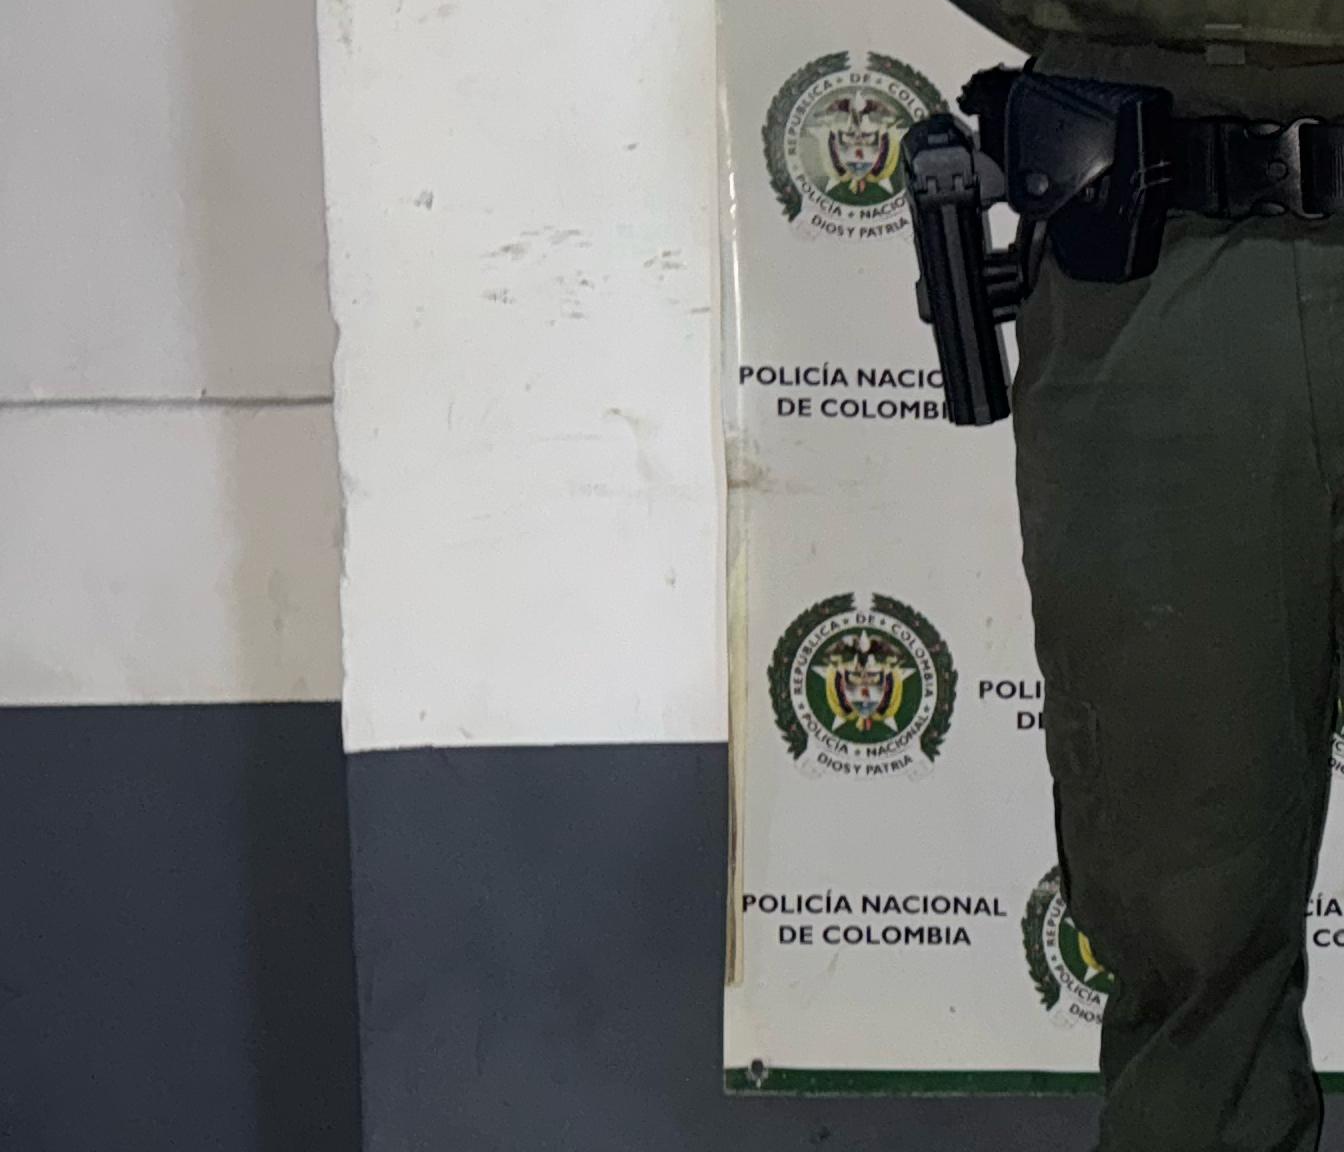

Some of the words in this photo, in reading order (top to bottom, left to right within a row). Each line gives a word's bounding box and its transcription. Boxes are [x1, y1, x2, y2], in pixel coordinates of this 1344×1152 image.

[850, 73, 872, 85] DE
[739, 362, 849, 387] POLICÍA
[857, 368, 945, 389] NACIO
[777, 397, 811, 417] DE
[820, 398, 949, 420] COLOMBI
[855, 615, 876, 626] DE
[889, 623, 935, 698] COLOMBIA
[979, 679, 1041, 700] POLI
[866, 712, 930, 757] NACIONAL
[865, 756, 914, 775] PATRIA
[741, 890, 853, 914] POLICÍA
[861, 895, 1007, 917] NACIONAL
[779, 925, 813, 945] DE
[822, 925, 971, 946] COLOMBIA
